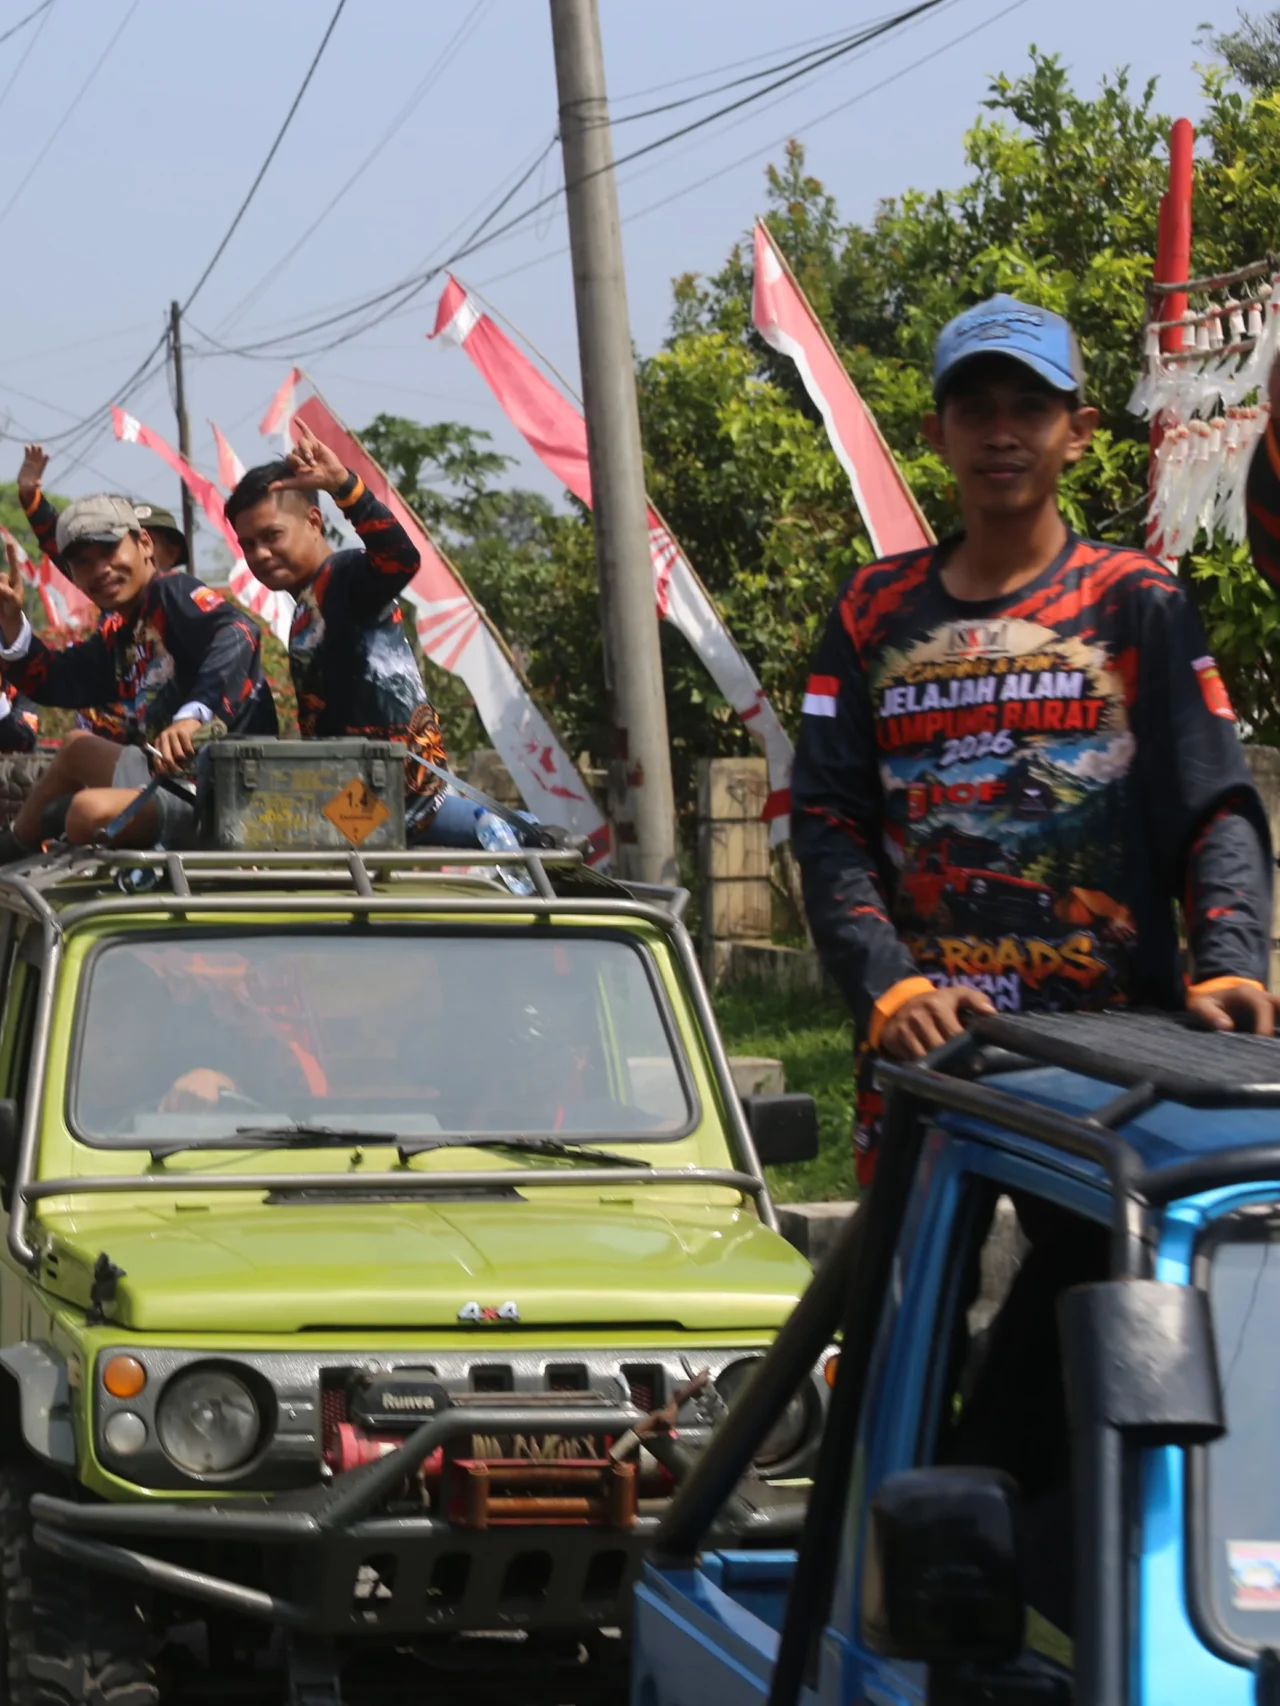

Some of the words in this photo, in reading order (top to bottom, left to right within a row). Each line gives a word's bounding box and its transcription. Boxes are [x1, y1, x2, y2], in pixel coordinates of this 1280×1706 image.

[879, 675, 999, 718] JELAJAH
[999, 671, 1085, 701] ALAM
[876, 702, 1000, 749] LAMPUNG
[1002, 699, 1107, 731] BARAT
[939, 728, 1016, 767] 2026
